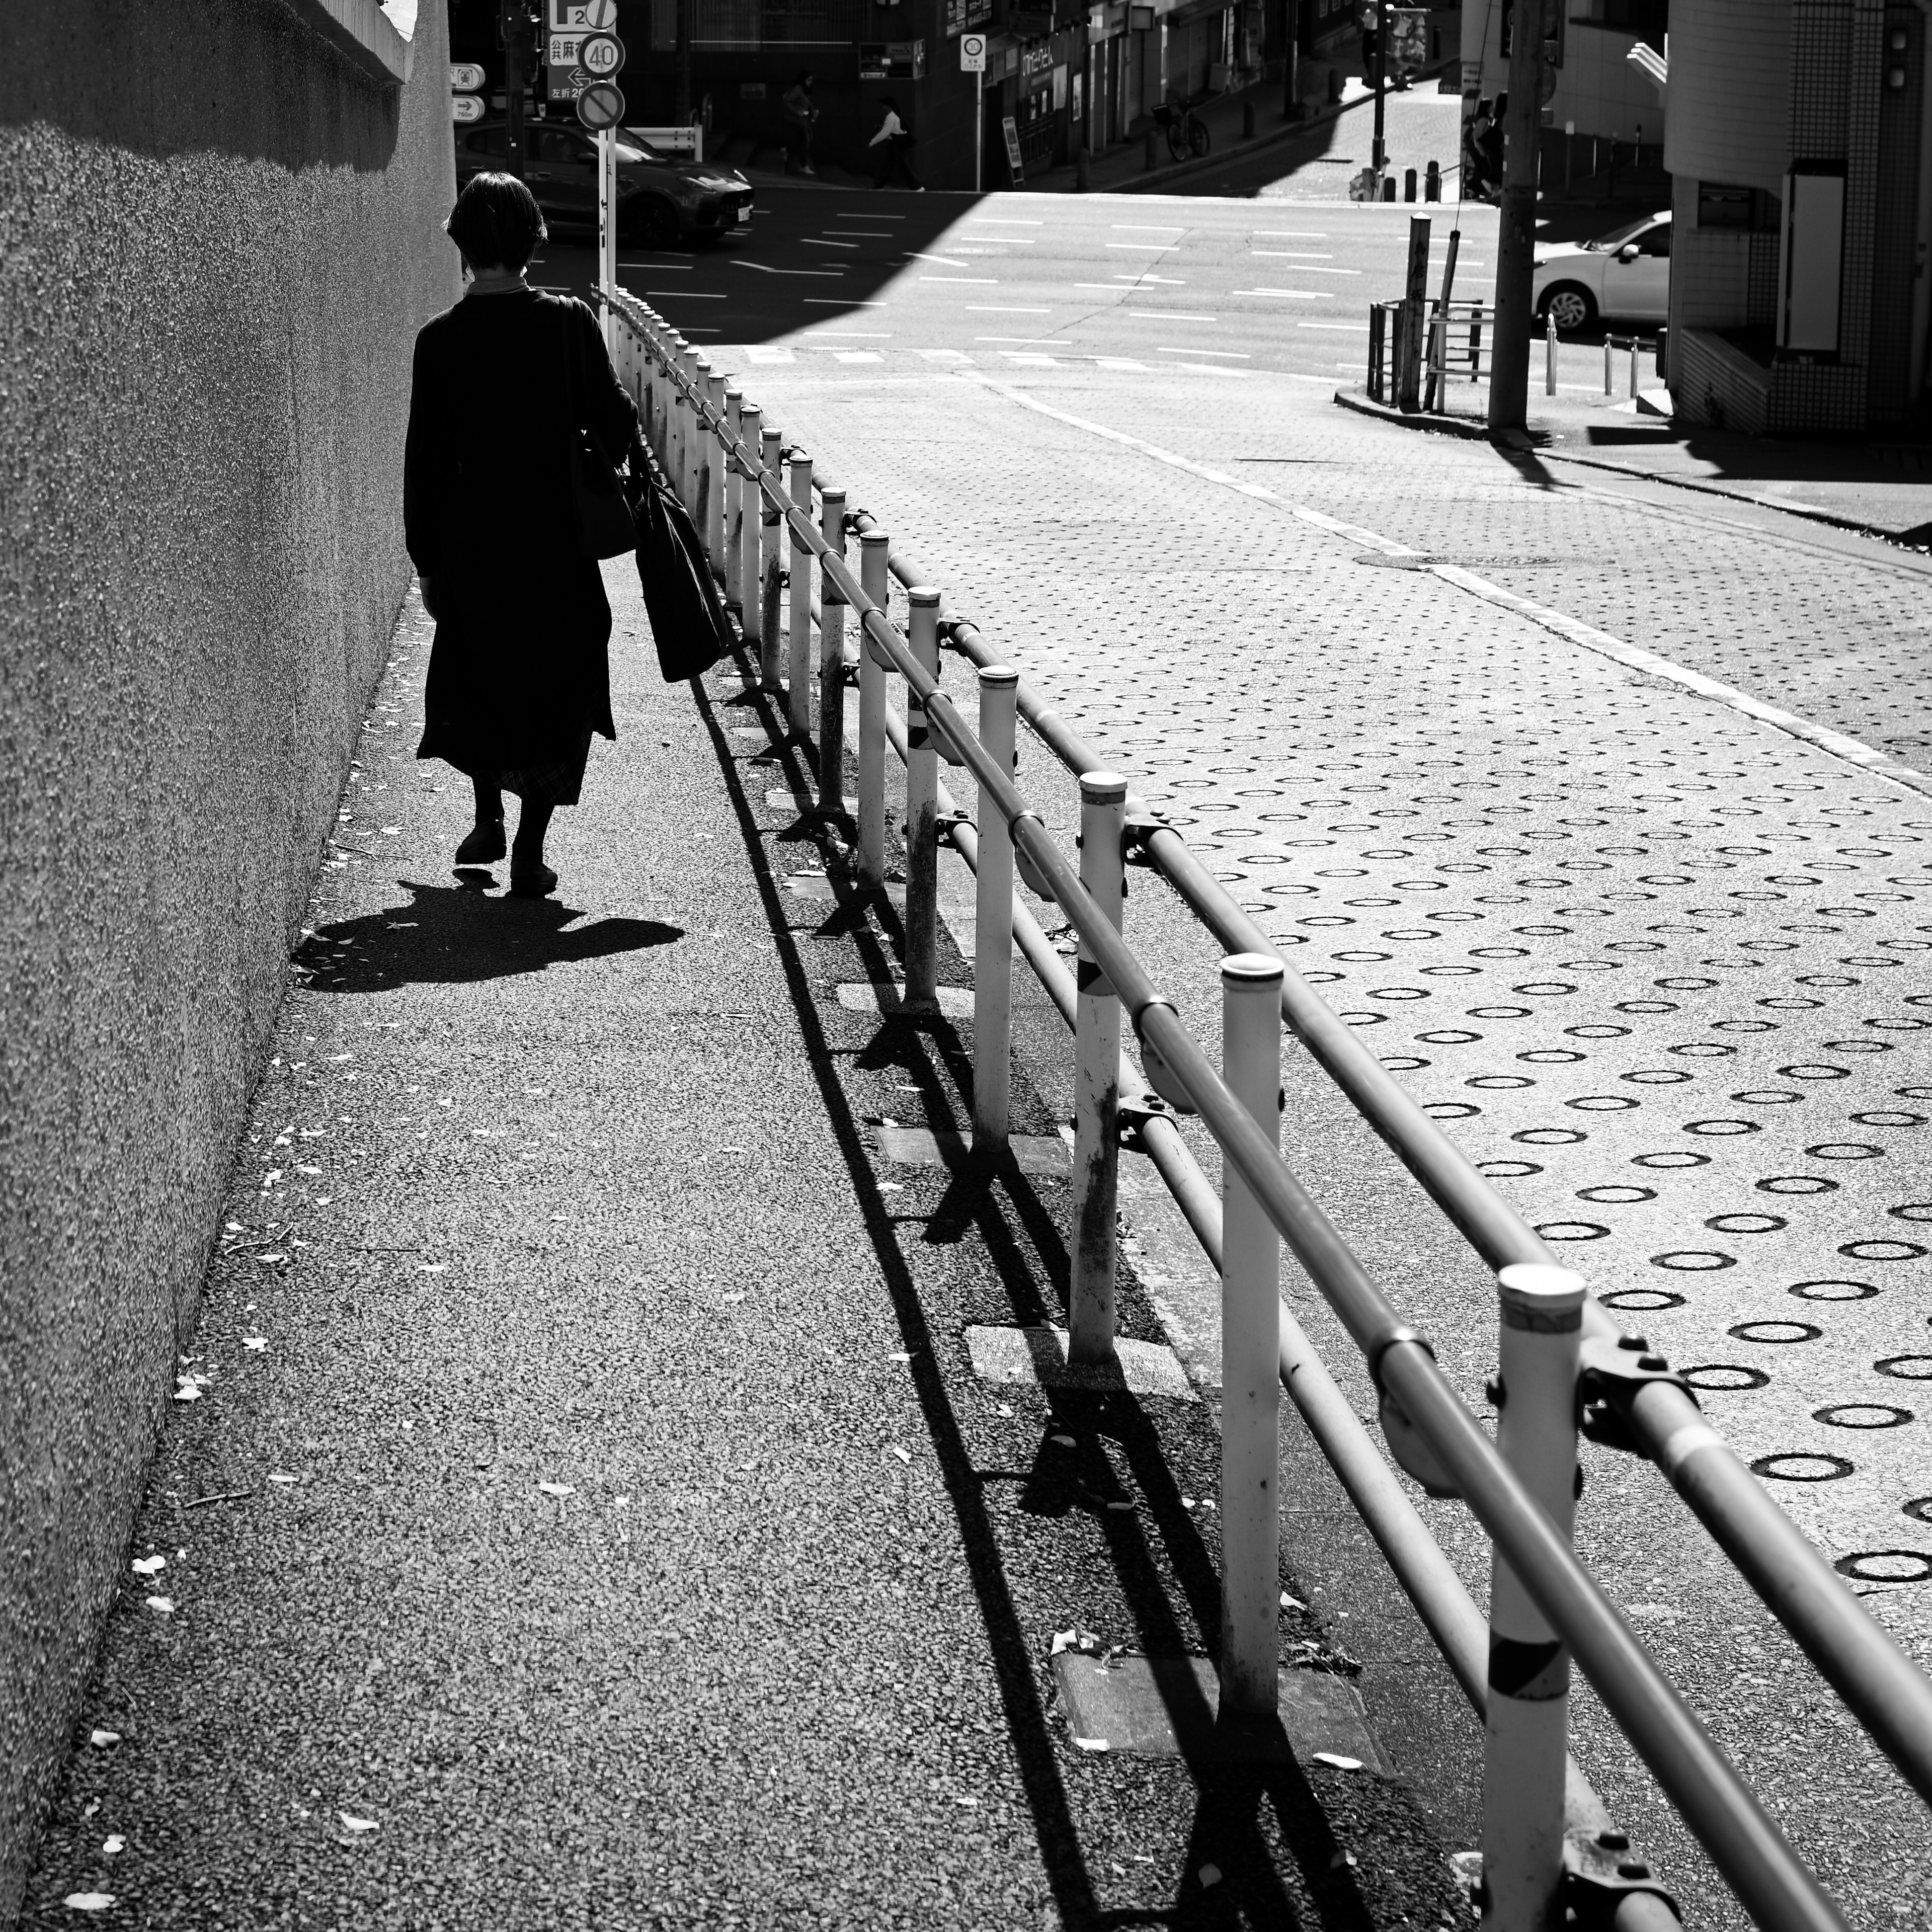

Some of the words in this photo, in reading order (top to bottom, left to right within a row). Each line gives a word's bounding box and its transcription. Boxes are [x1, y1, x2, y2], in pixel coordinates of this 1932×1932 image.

[969, 42, 979, 51] 30
[589, 45, 614, 66] 40
[552, 88, 570, 98] 左折
